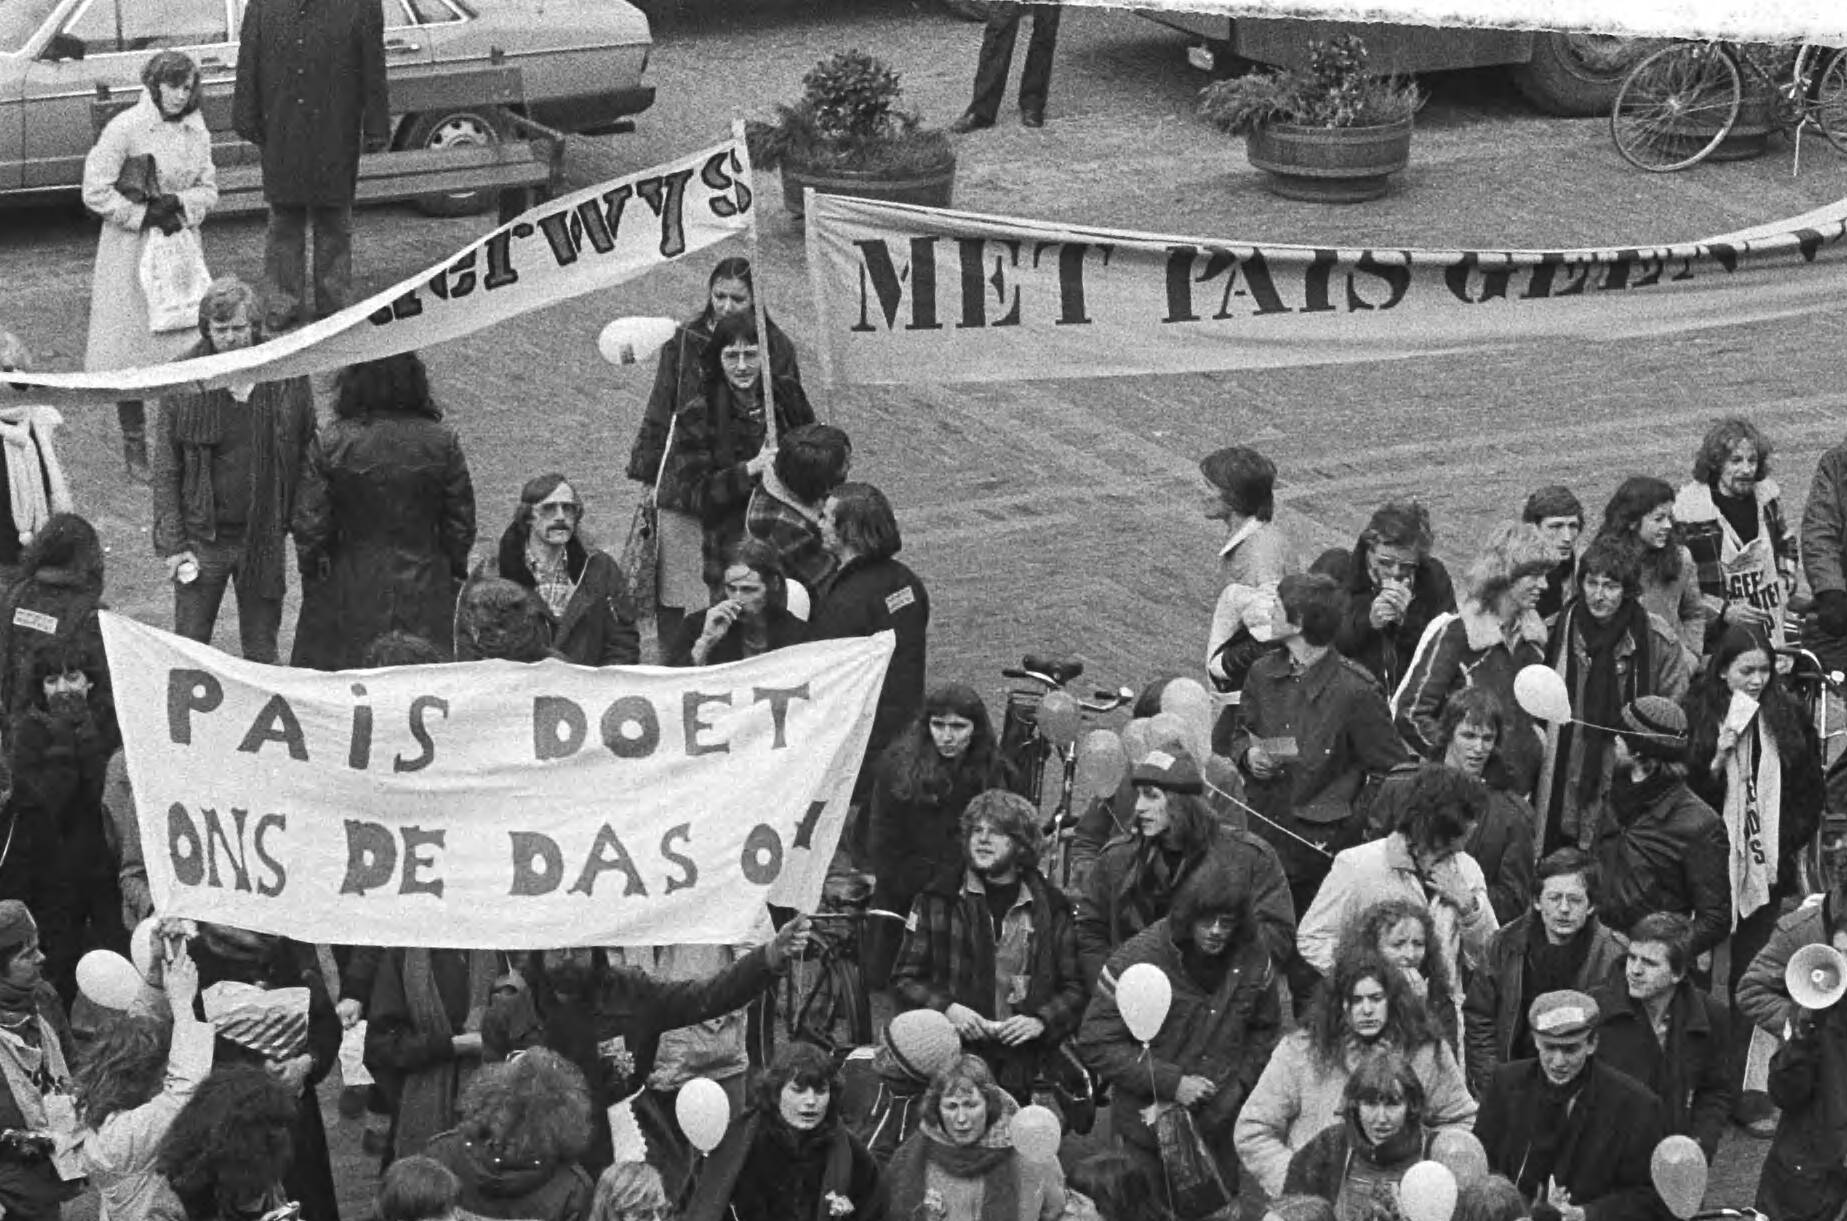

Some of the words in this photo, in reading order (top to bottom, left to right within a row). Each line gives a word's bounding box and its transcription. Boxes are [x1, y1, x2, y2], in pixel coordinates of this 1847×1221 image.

[852, 236, 1114, 331] MET
[1162, 246, 1412, 324] PAIS
[532, 682, 813, 760] DOET
[167, 801, 288, 898] ONS
[340, 818, 447, 900] DE
[507, 822, 699, 899] DAS
